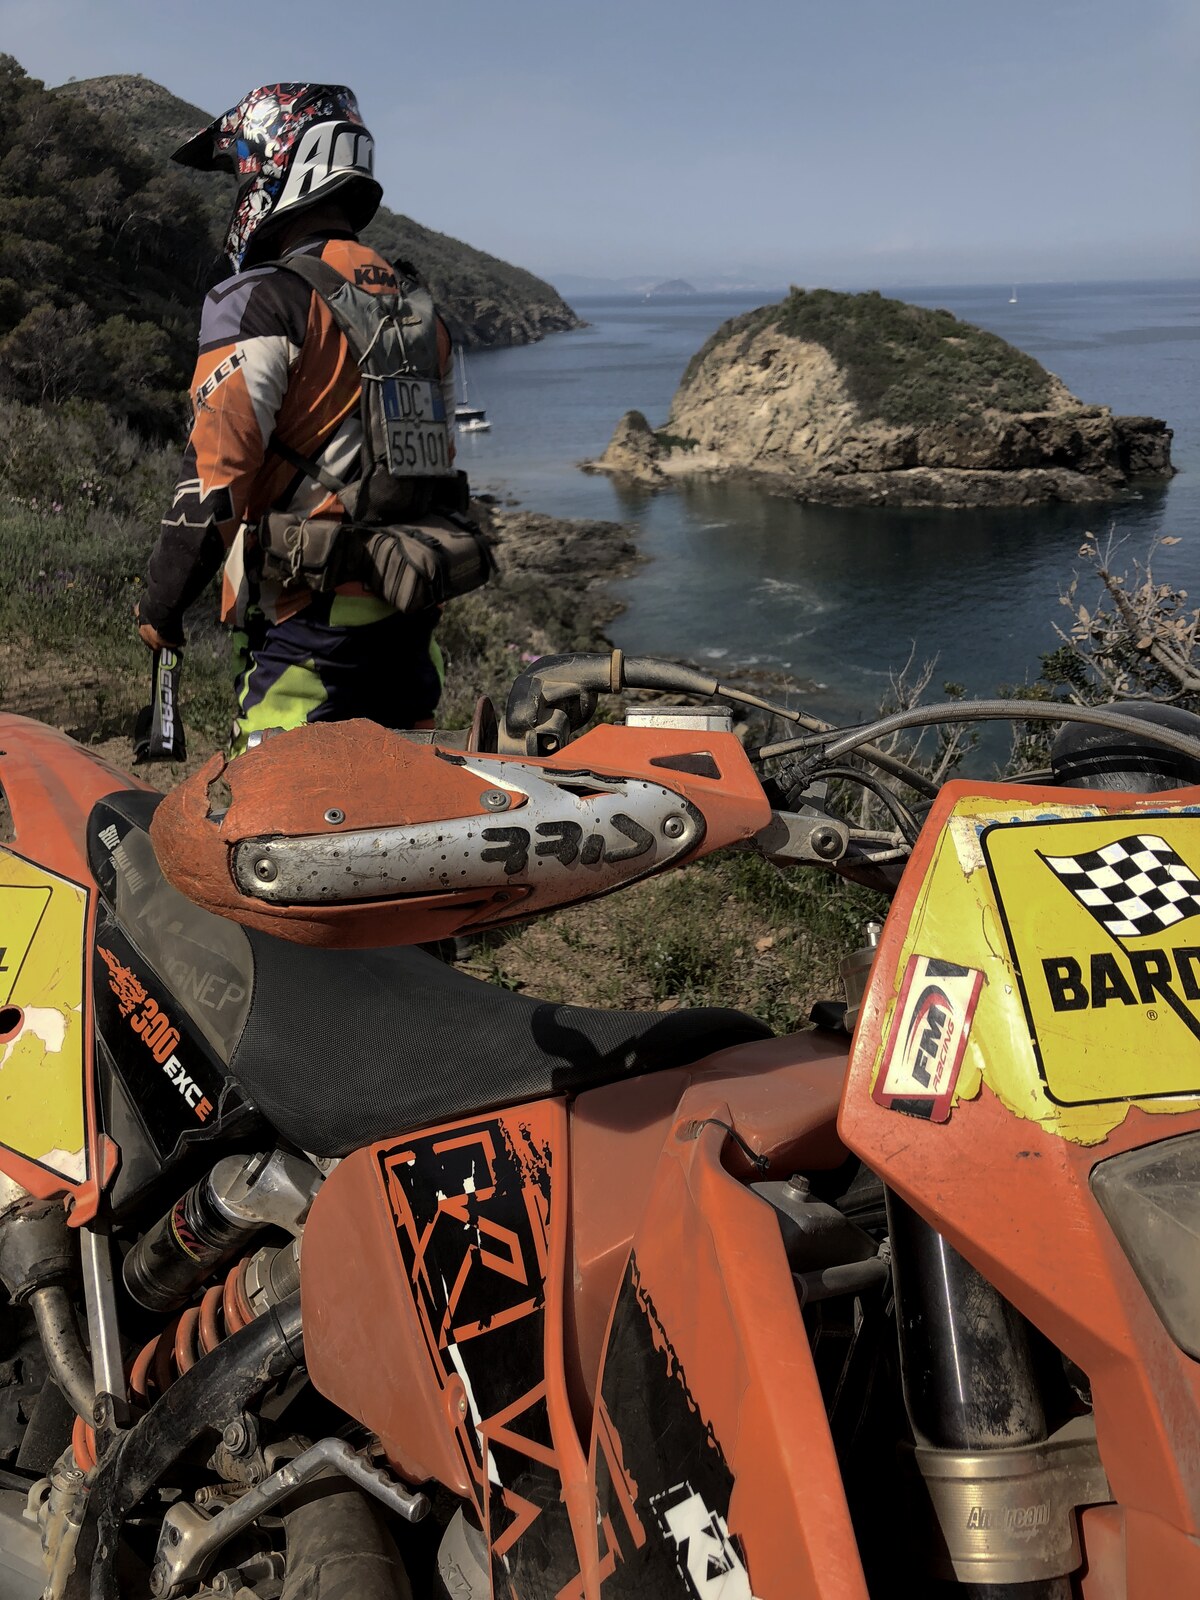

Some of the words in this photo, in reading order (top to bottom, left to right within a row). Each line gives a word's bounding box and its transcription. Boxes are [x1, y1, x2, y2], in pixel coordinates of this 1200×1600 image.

[354, 264, 398, 289] KTM
[196, 349, 248, 402] ECH
[398, 382, 424, 417] DC
[392, 431, 446, 468] 55101
[131, 998, 180, 1064] 300
[911, 1004, 947, 1090] FM
